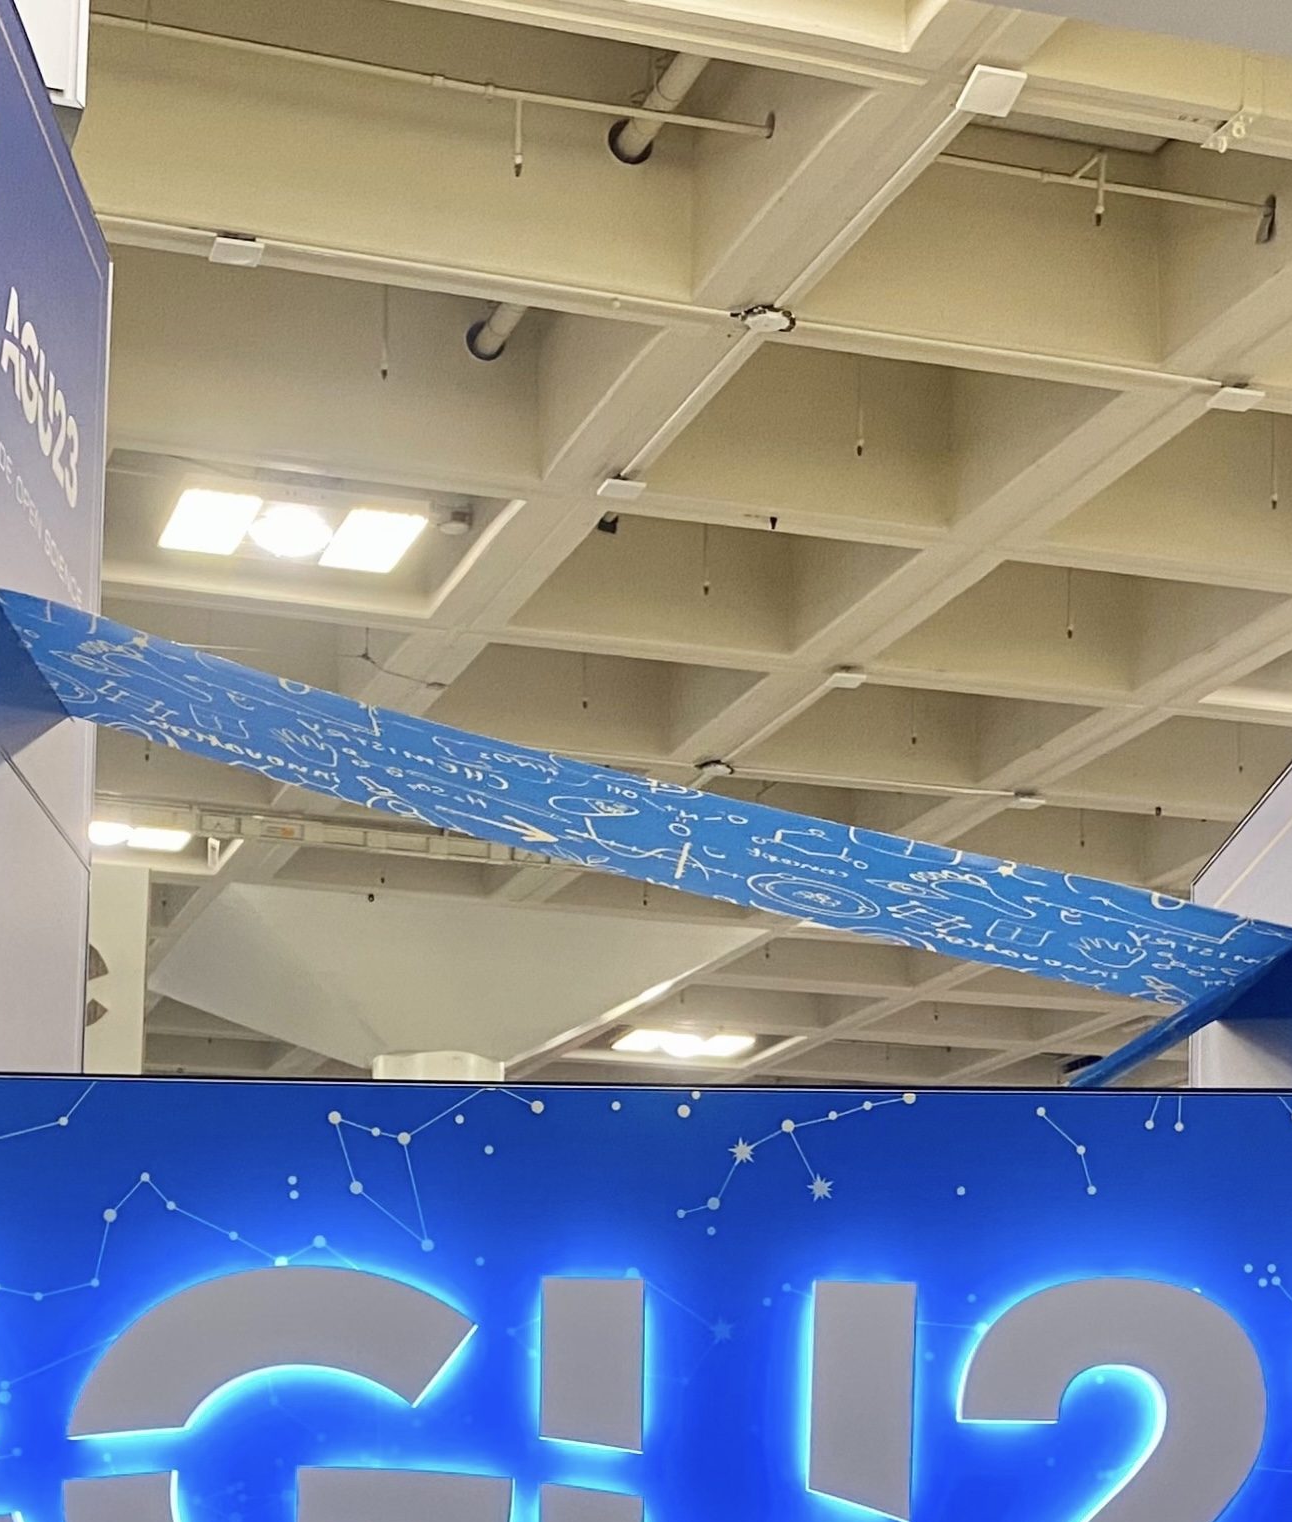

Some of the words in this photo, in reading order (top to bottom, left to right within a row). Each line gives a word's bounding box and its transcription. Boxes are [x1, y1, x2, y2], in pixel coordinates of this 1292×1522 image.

[0, 287, 79, 509] AGU23
[15, 475, 44, 540] OPEN
[44, 528, 83, 610] SCIENCE
